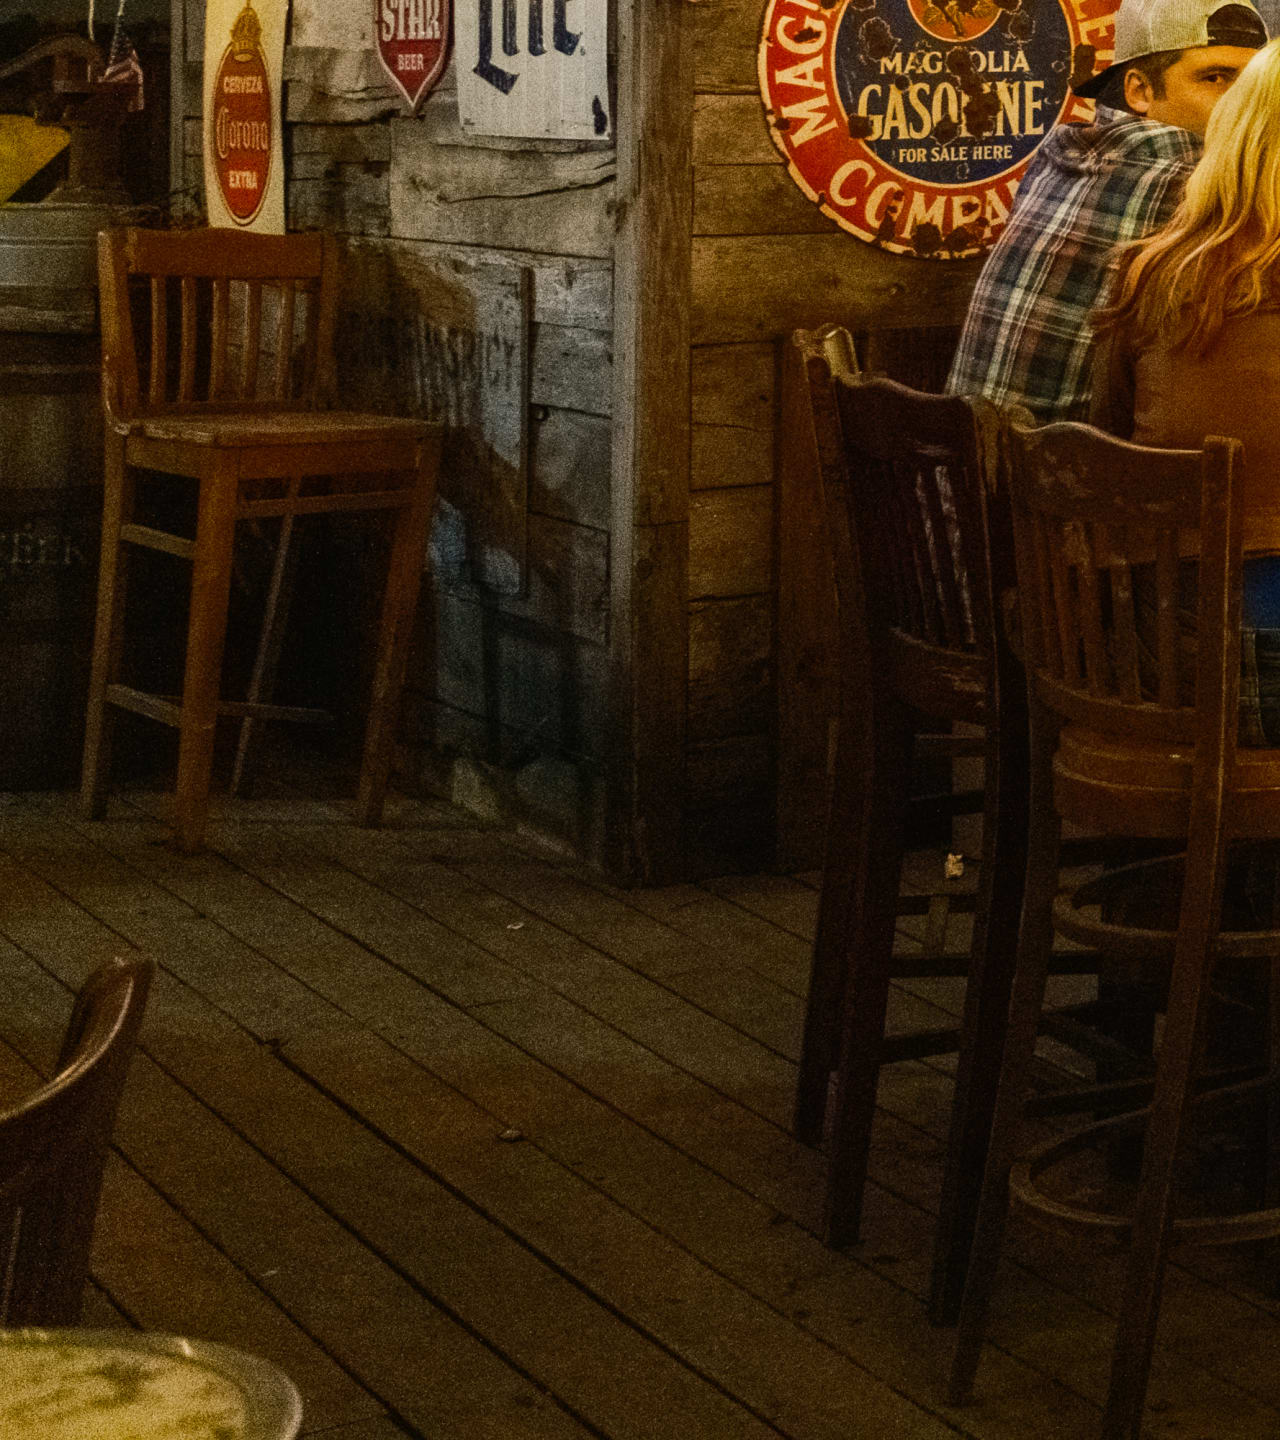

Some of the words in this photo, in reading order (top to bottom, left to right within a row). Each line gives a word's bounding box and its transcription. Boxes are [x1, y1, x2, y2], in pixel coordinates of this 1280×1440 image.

[397, 53, 425, 71] BEER
[879, 49, 1031, 75] MAGOLIA
[223, 75, 264, 94] CERVEZA
[216, 105, 270, 160] Corona
[898, 148, 928, 163] FOR
[930, 146, 969, 162] SALE
[972, 144, 1014, 161] HERE
[228, 170, 258, 190] EXTRA
